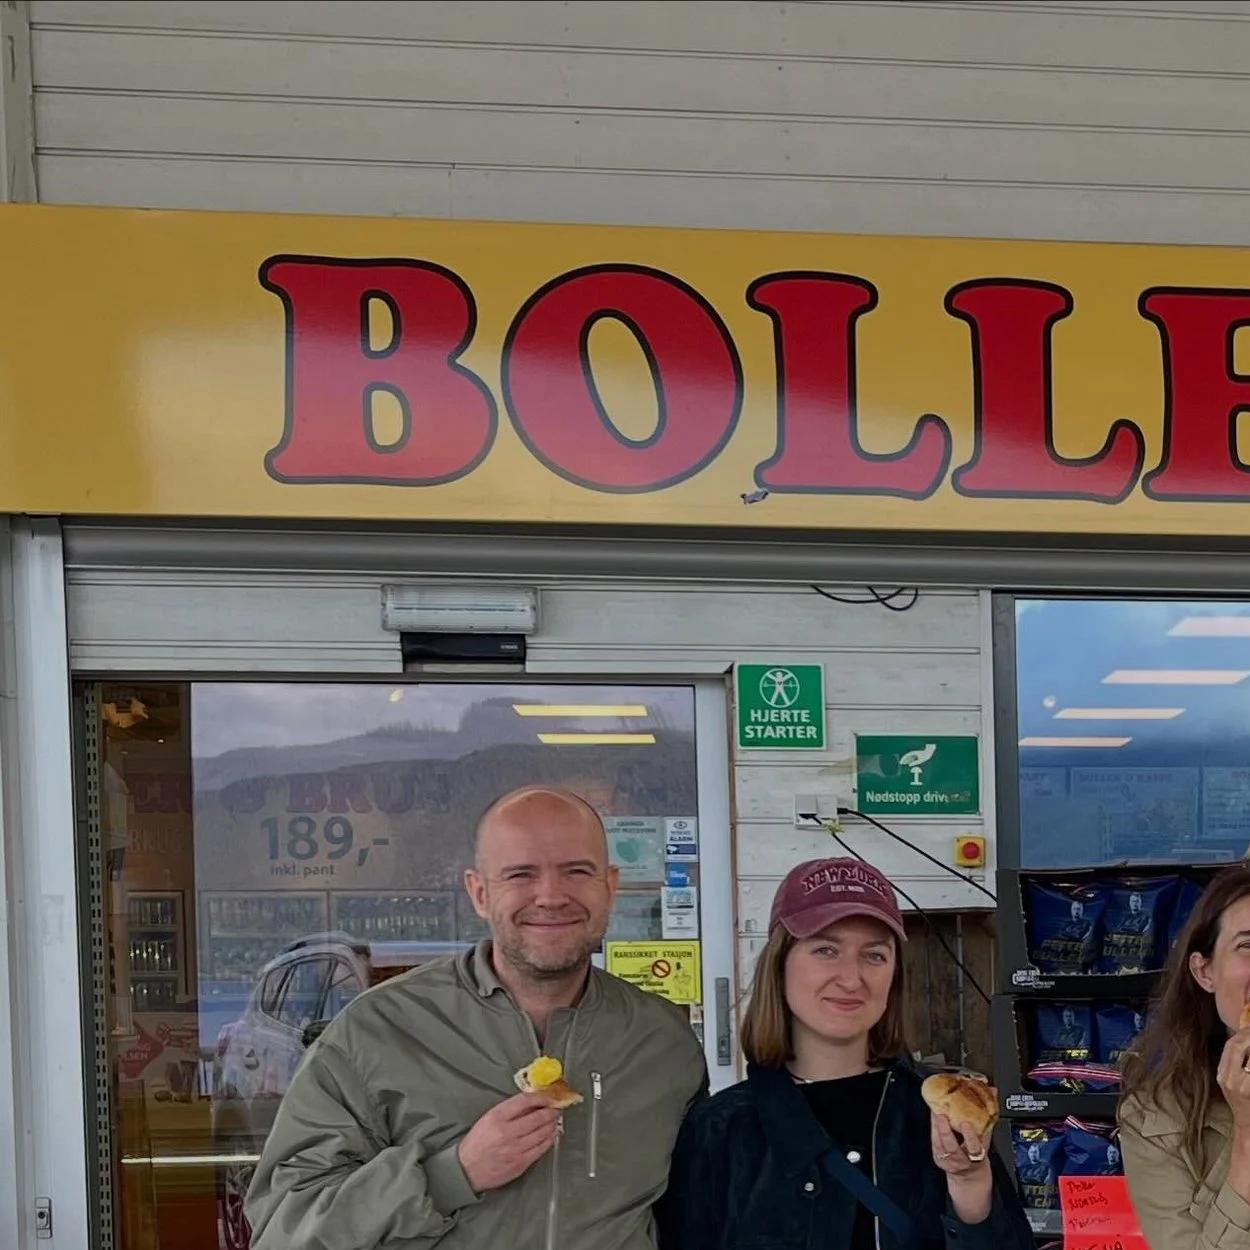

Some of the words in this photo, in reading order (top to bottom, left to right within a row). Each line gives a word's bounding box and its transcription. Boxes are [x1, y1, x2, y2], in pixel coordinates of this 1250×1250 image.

[750, 709, 811, 723] HJERTE
[745, 725, 817, 739] STARTER
[866, 791, 921, 804] Nødstopp
[260, 816, 389, 867] 189,-
[303, 864, 334, 878] pant
